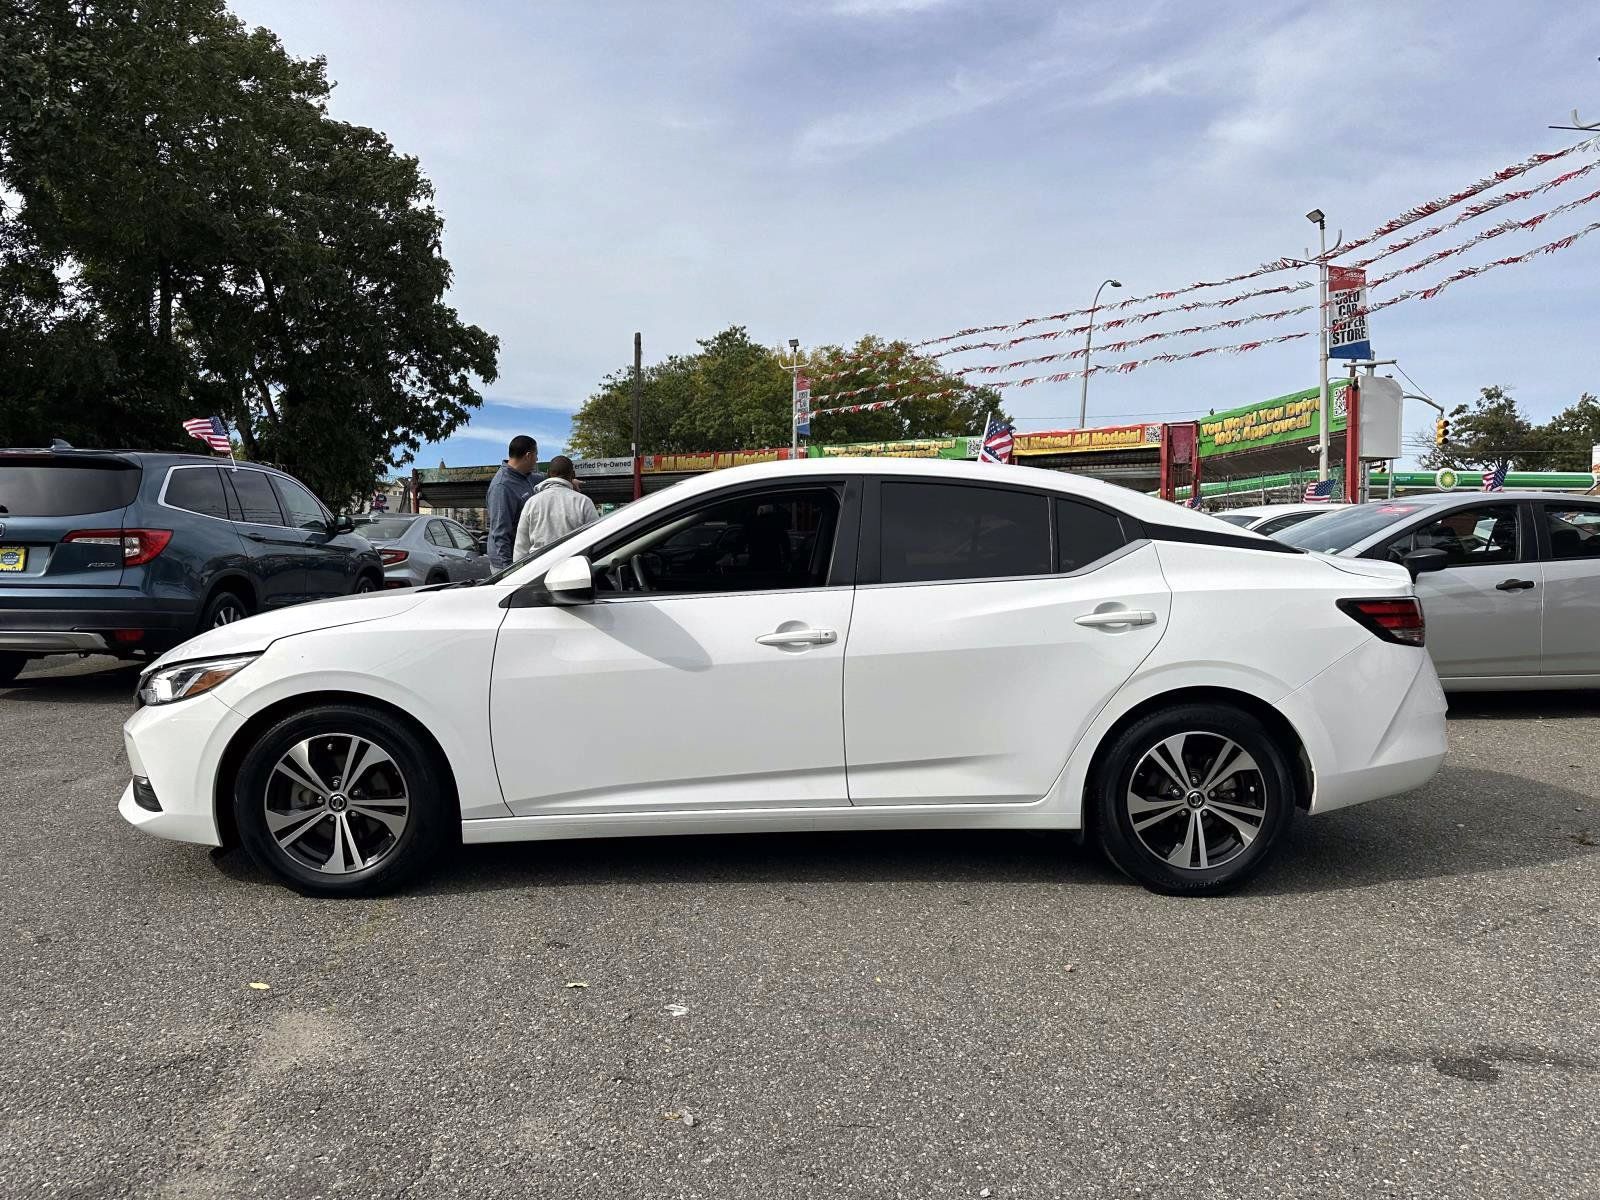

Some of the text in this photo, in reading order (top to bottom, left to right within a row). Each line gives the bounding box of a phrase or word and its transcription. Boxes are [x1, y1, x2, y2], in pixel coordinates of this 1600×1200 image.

[1338, 303, 1358, 316] CAR
[1332, 327, 1366, 345] STORE
[1258, 406, 1284, 422] You
[1214, 428, 1241, 446] 100%
[574, 461, 632, 470] ertified Pre-Owned
